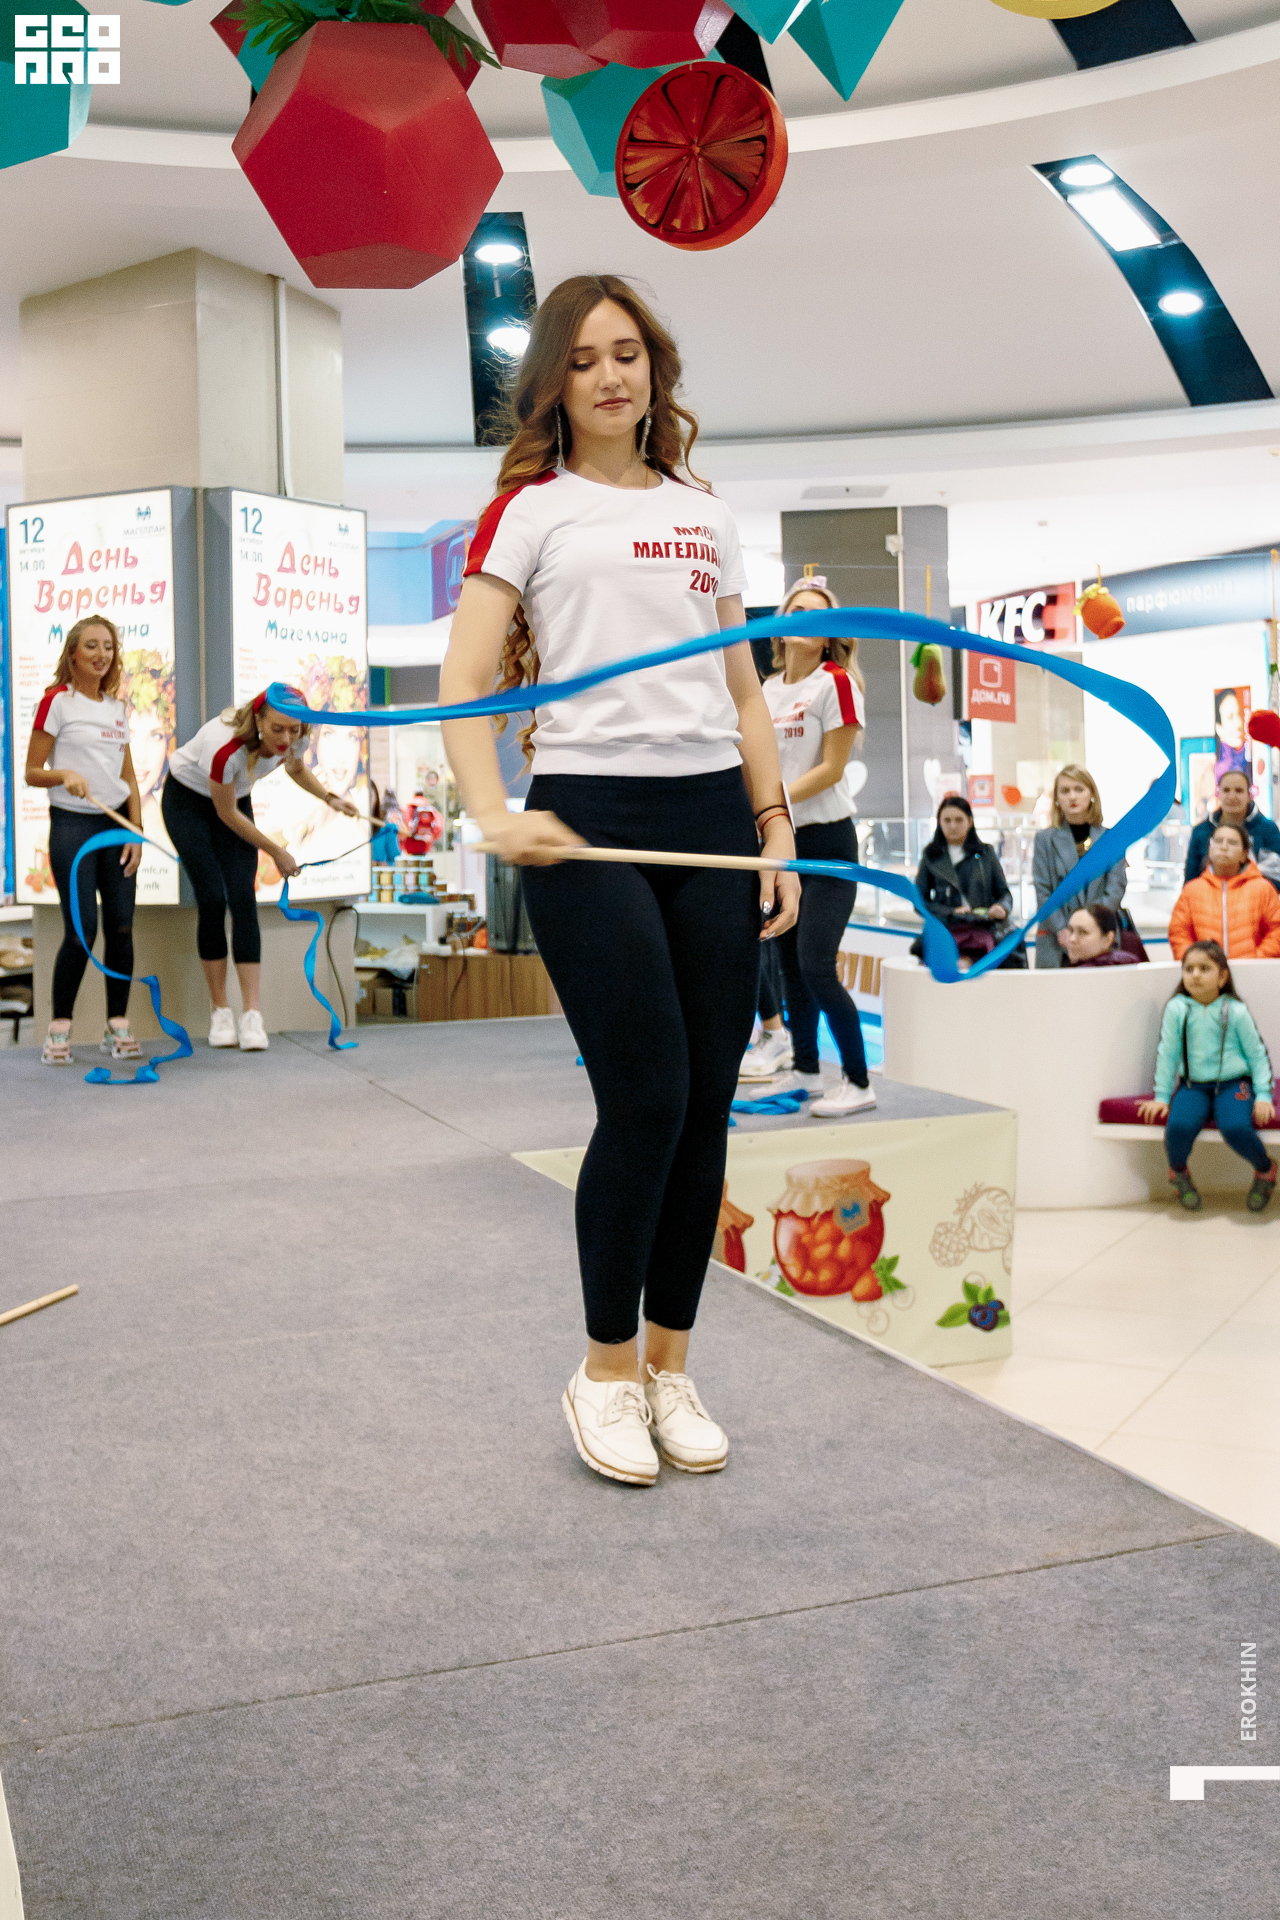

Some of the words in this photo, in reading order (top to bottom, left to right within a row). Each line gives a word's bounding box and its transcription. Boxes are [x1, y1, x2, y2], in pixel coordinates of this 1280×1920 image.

[20, 517, 45, 544] 12
[240, 507, 262, 535] 12
[673, 525, 713, 541] МИС
[61, 541, 138, 575] День
[277, 541, 339, 578] День
[34, 580, 166, 618] Варенья
[253, 572, 360, 617] Варенья
[265, 619, 347, 644] Магеллана
[979, 591, 1047, 644] KFC
[784, 726, 804, 738] 2019
